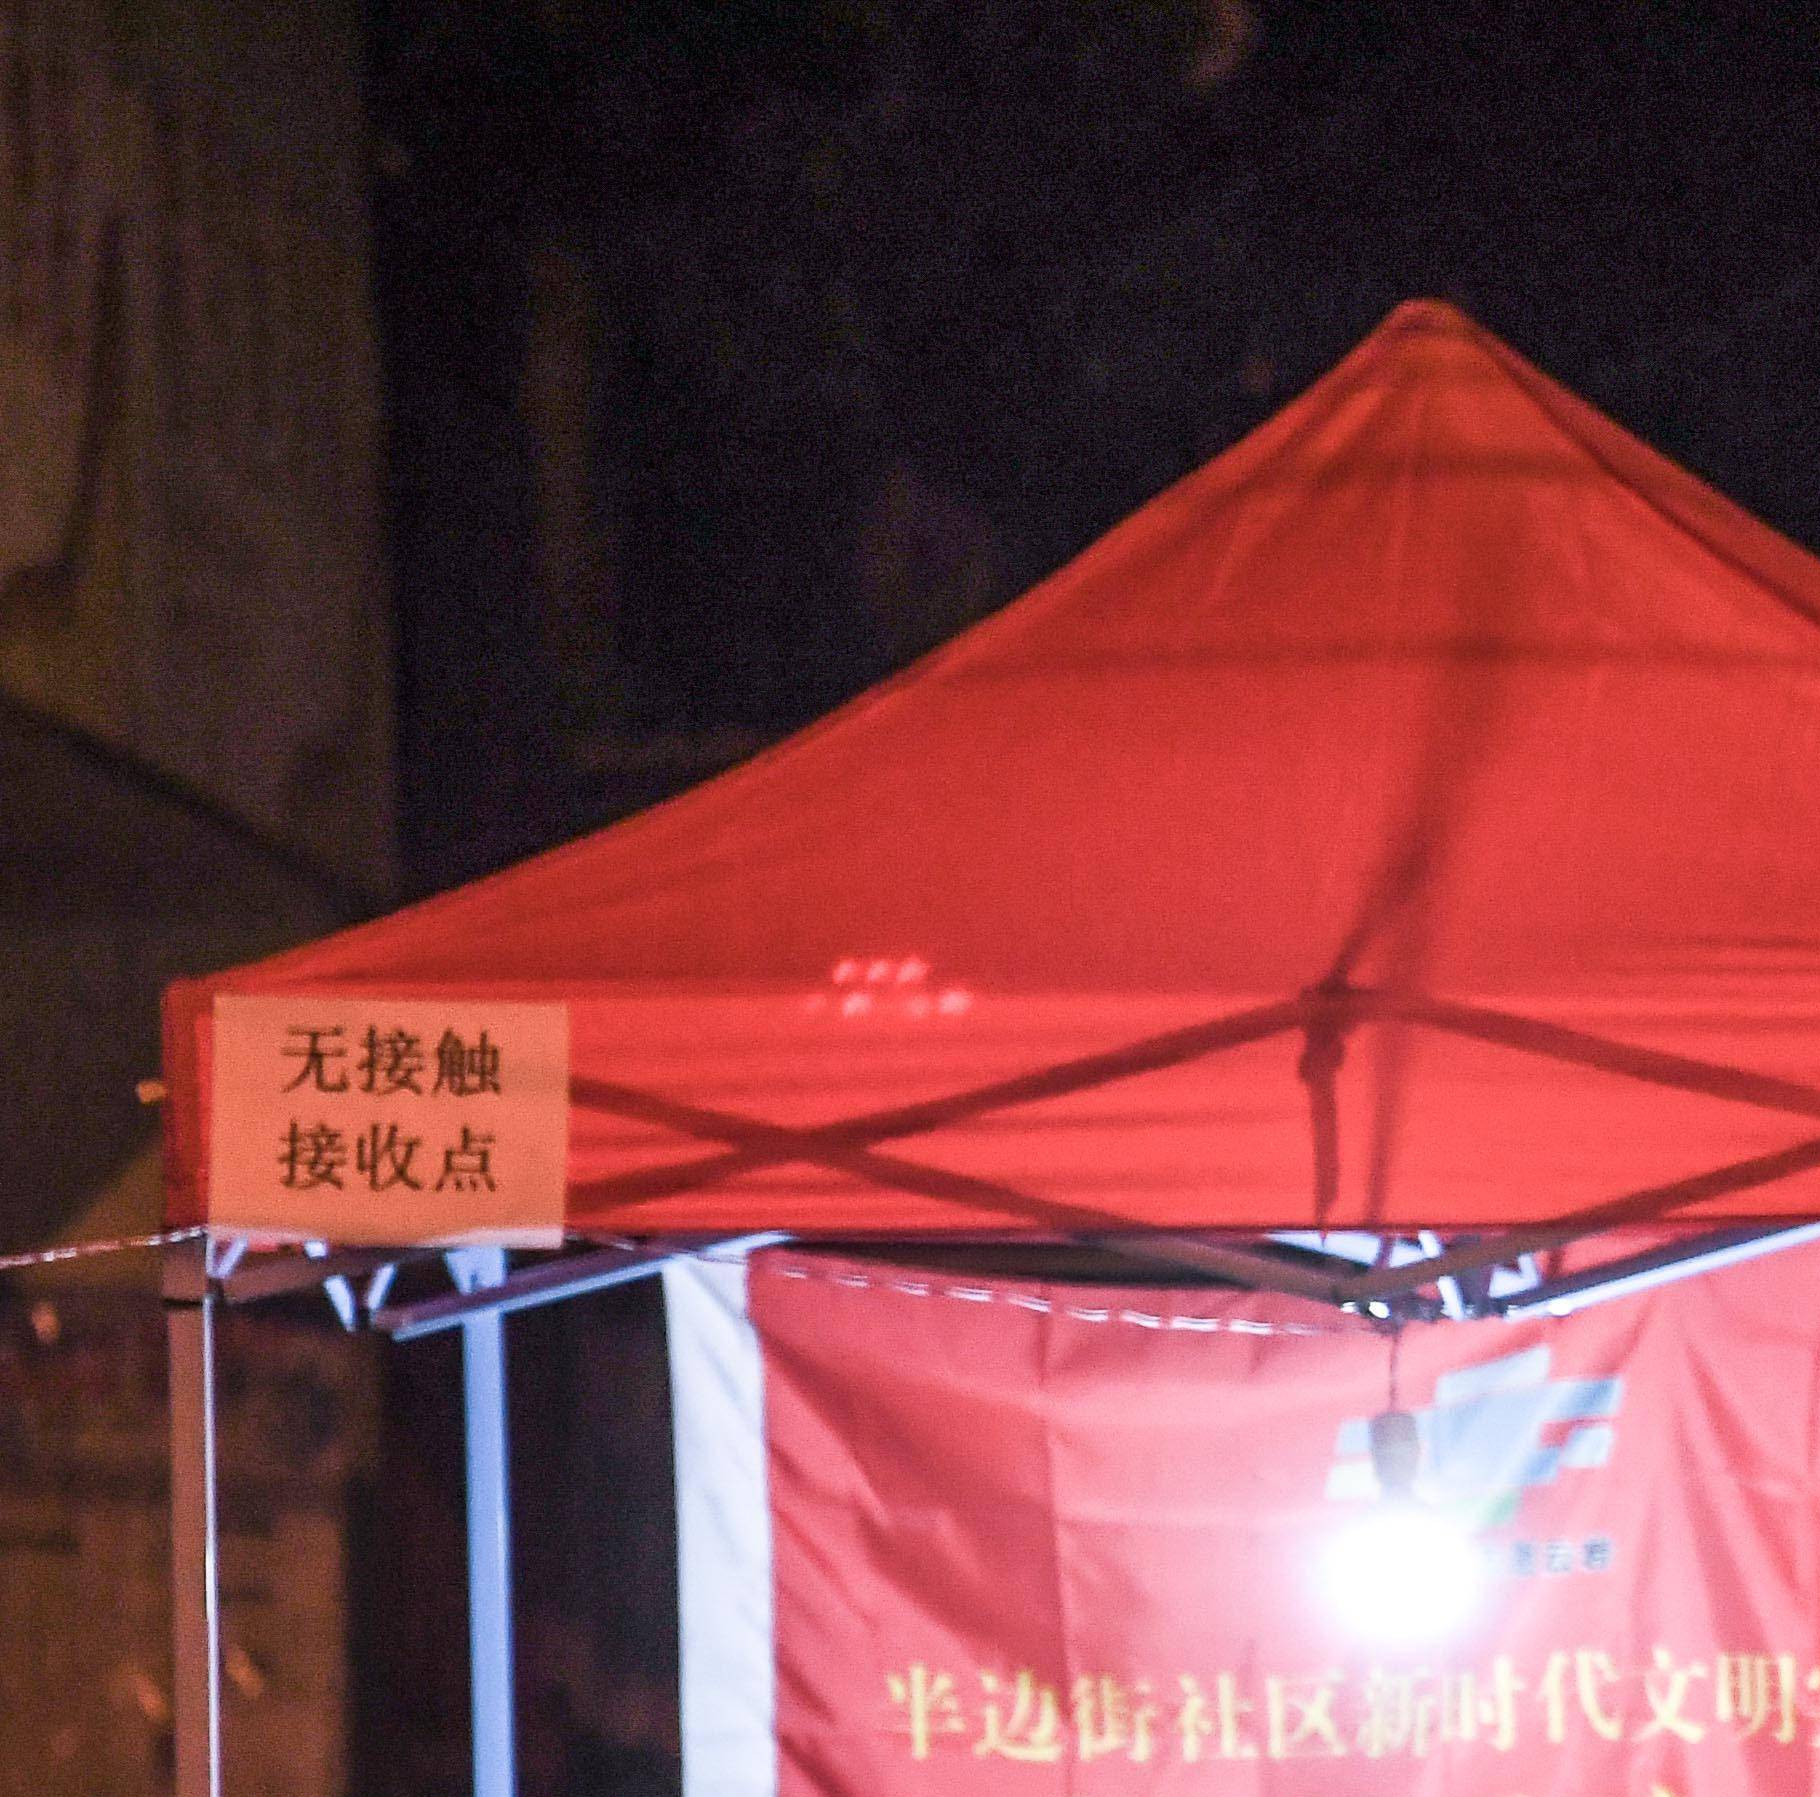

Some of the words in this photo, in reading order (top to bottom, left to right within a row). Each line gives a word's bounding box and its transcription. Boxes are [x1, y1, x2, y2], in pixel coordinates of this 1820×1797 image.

[280, 1024, 500, 1096] 无接触
[278, 1117, 496, 1192] 接收点
